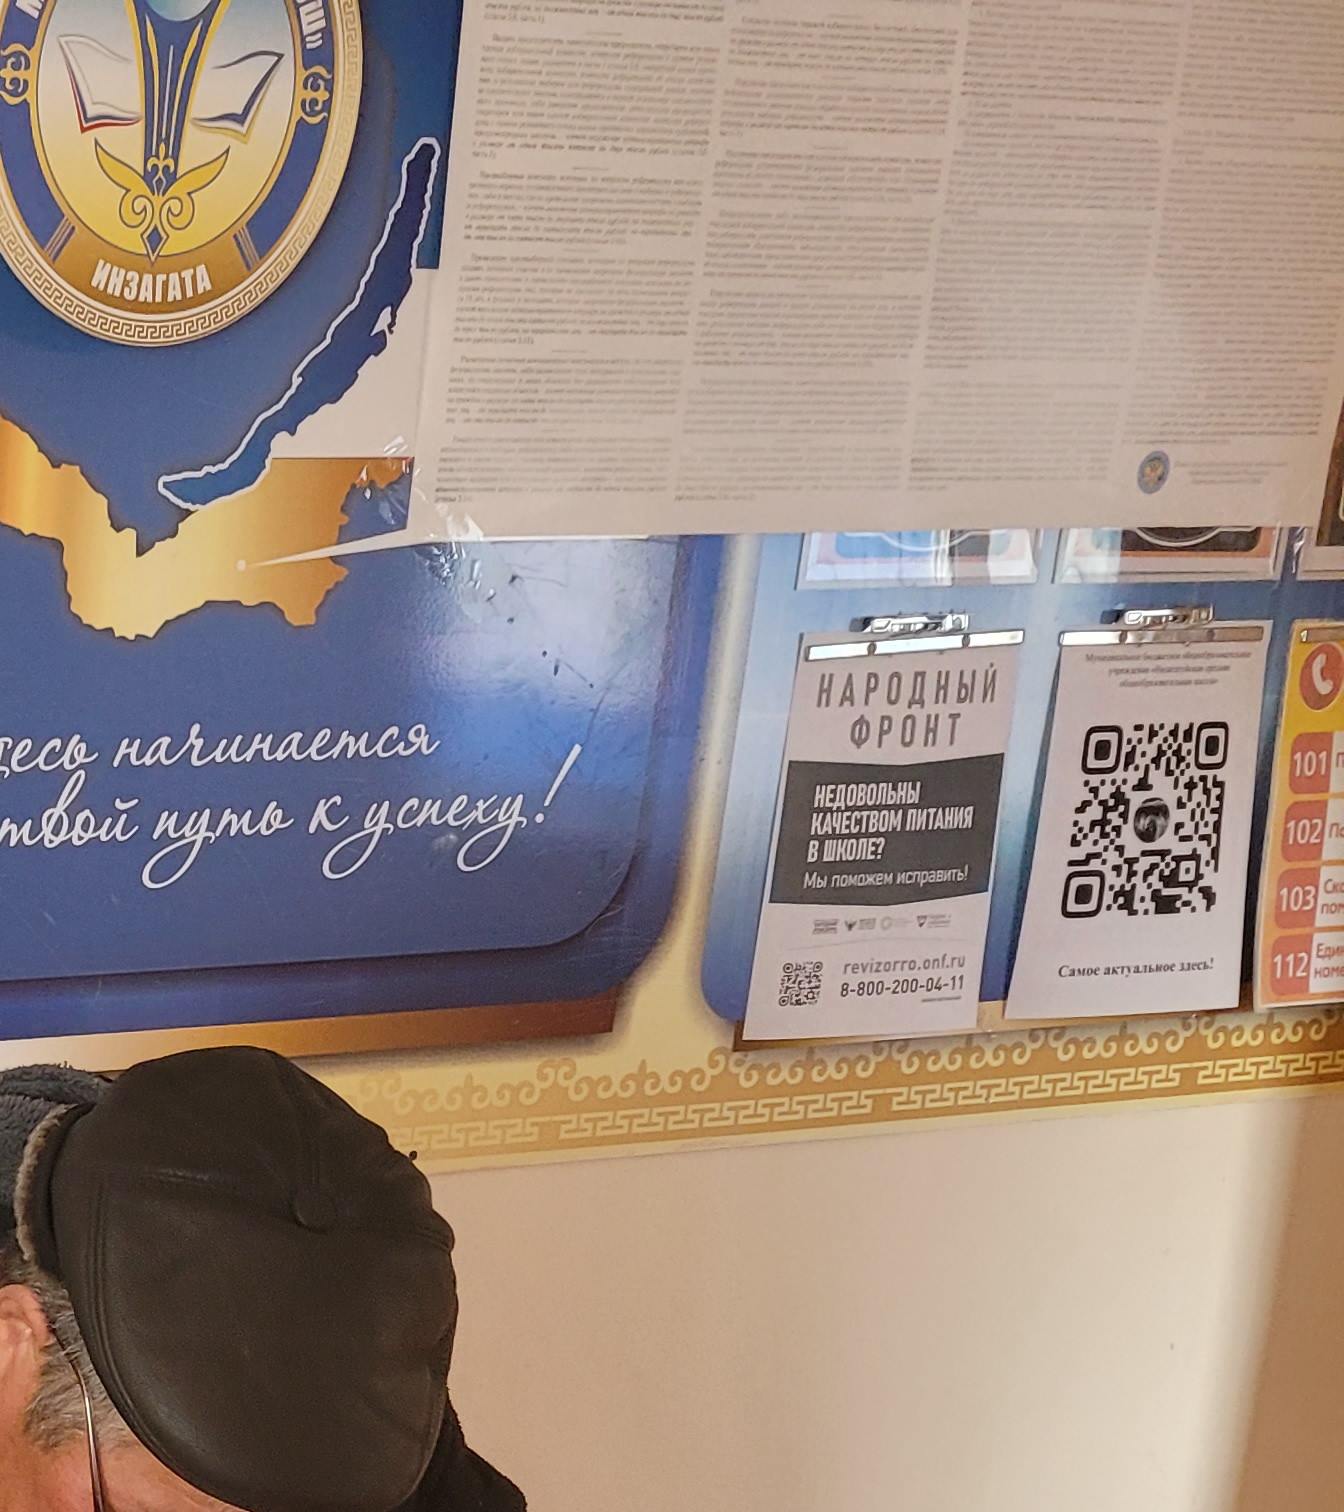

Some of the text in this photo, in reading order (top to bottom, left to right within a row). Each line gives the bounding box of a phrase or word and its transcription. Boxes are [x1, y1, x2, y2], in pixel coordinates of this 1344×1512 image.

[91, 259, 212, 303] ИНЗАГАТА
[815, 663, 999, 709] НАРОДНЫЙ
[112, 723, 444, 768] начинается
[850, 713, 961, 749] ФРОНТ
[1292, 749, 1328, 778] 101
[814, 781, 921, 811] НЕДОВОЛЬНЫ
[308, 795, 349, 834] к
[320, 742, 582, 880] успеху!
[810, 806, 974, 836] КАЧЕСТВОМ ПИТАНИЯ
[141, 800, 294, 889] путь
[1286, 819, 1322, 844] 102
[807, 837, 885, 862] В ШКОЛЕ?
[803, 864, 969, 890] Мы поможем исправить!
[1279, 886, 1316, 912] 103
[843, 954, 965, 974] revizorro.onf.ru
[1058, 957, 1214, 979] Самое актуальное здесь!
[1273, 952, 1308, 979] 112
[840, 975, 964, 997] 8-800-200-04-11
